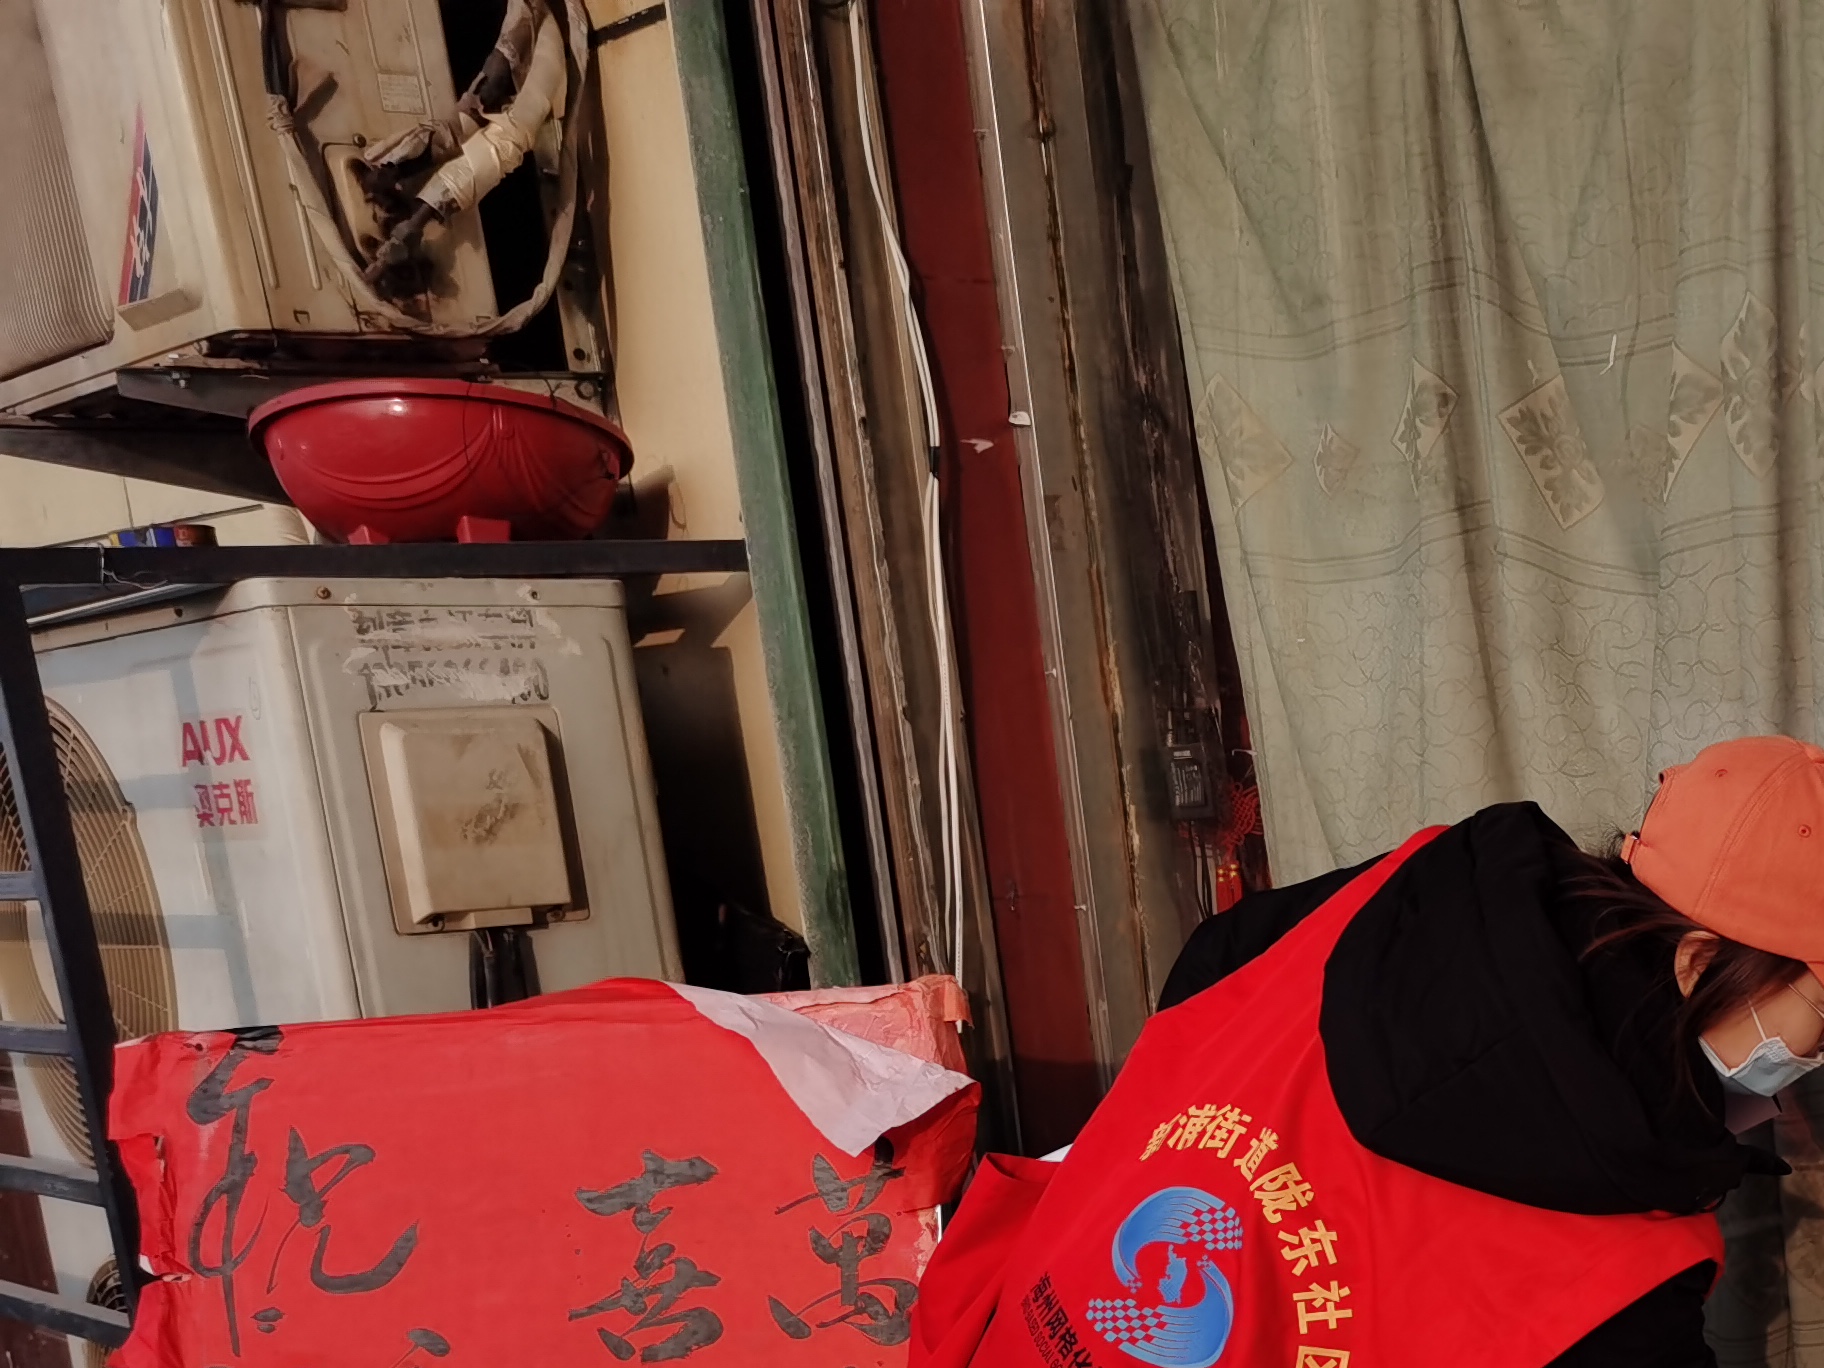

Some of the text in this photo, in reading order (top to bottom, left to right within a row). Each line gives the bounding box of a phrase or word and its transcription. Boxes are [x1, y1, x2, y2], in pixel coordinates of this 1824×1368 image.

[182, 715, 251, 768] AUX
[194, 778, 259, 828] 奥克斯
